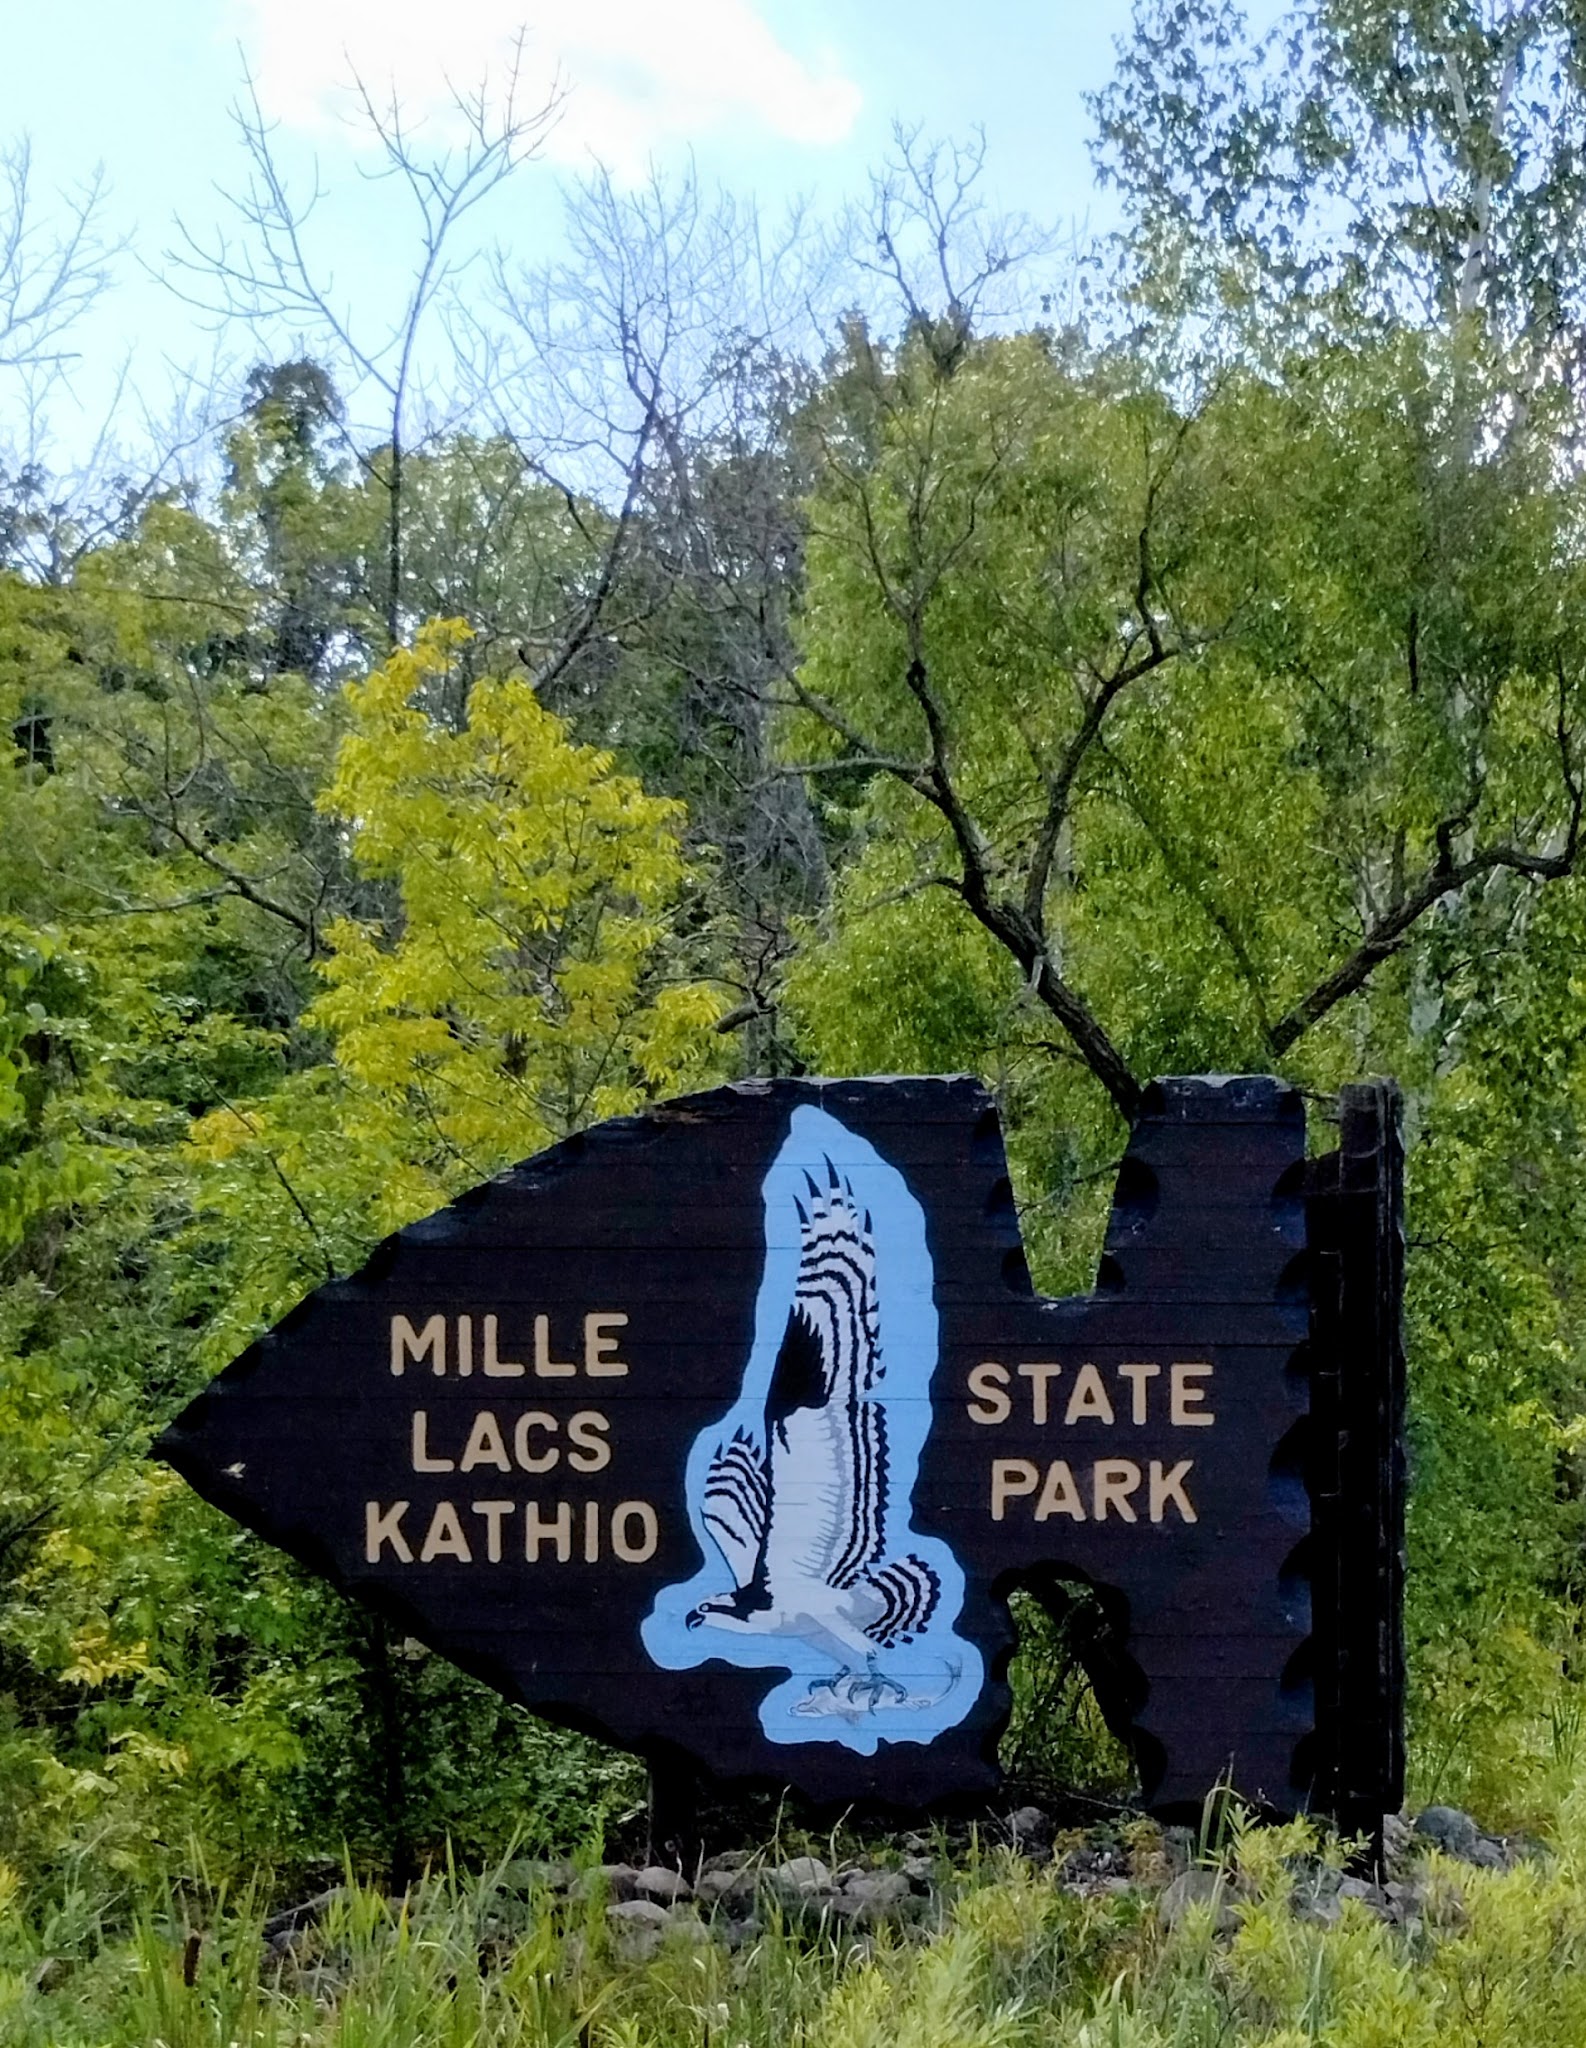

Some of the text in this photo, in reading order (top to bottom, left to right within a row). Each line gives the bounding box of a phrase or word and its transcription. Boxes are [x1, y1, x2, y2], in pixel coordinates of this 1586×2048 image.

[390, 1313, 629, 1378] MILLE
[967, 1362, 1215, 1426] STATE
[412, 1410, 611, 1473] LACS
[991, 1459, 1198, 1523] PARK
[366, 1501, 658, 1563] KATHIO
